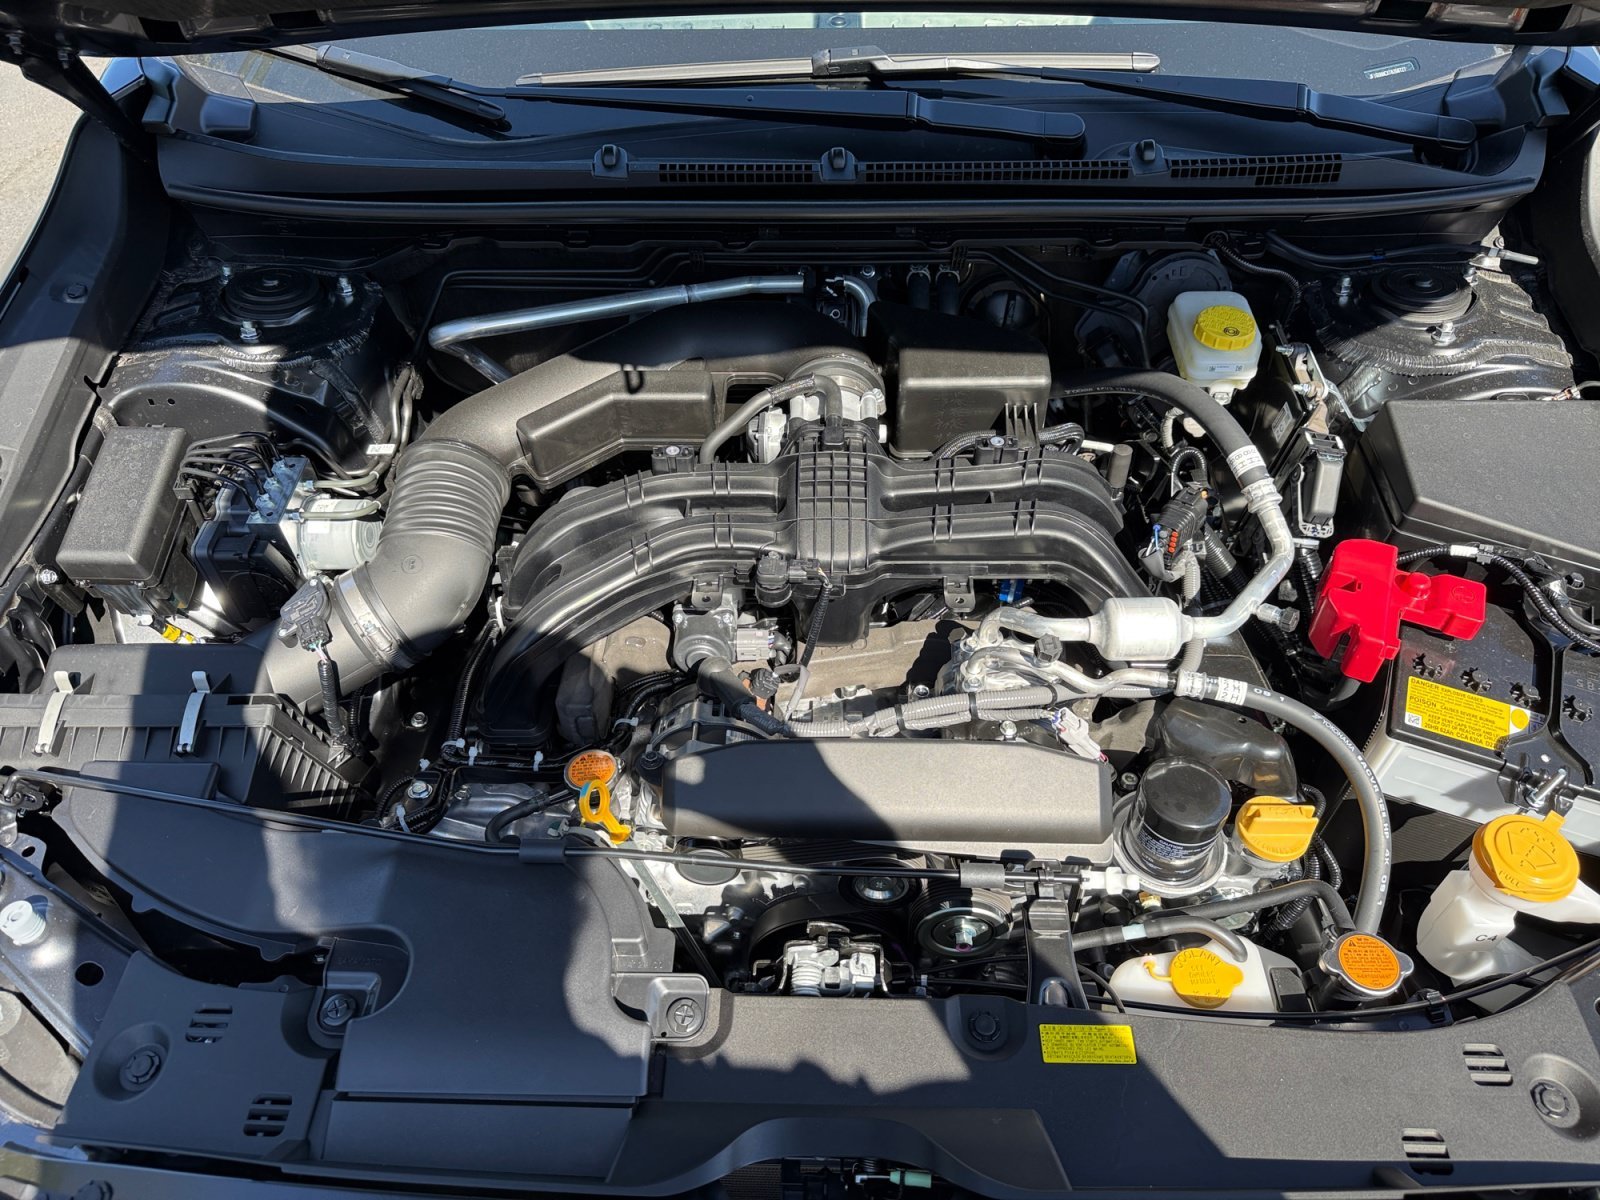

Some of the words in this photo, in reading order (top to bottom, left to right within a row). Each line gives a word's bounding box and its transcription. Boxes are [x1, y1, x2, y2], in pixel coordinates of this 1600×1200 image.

[1411, 678, 1440, 691] DANGER
[1441, 687, 1467, 698] EXPLOSIVE
[1409, 695, 1437, 708] POISON
[1440, 703, 1460, 715] CAUSES
[1460, 710, 1478, 720] SEVERE
[1424, 723, 1439, 732] 20HR
[1439, 727, 1454, 737] 62Ah
[1456, 732, 1469, 741] CCA
[1427, 718, 1441, 726] KEEP
[1440, 721, 1451, 729] OUT
[1459, 726, 1476, 736] REACH
[1428, 713, 1442, 722] KEEP
[1442, 716, 1454, 725] VENT
[1454, 720, 1467, 729] CAPS
[1468, 723, 1482, 733] TIGHT
[1321, 719, 1355, 753] YOKOHAMA
[1383, 823, 1390, 839] HP
[1158, 839, 1184, 850] CAUTION
[1384, 848, 1390, 865] 4K
[1475, 934, 1498, 942] C4
[1173, 949, 1222, 969] COOLANT
